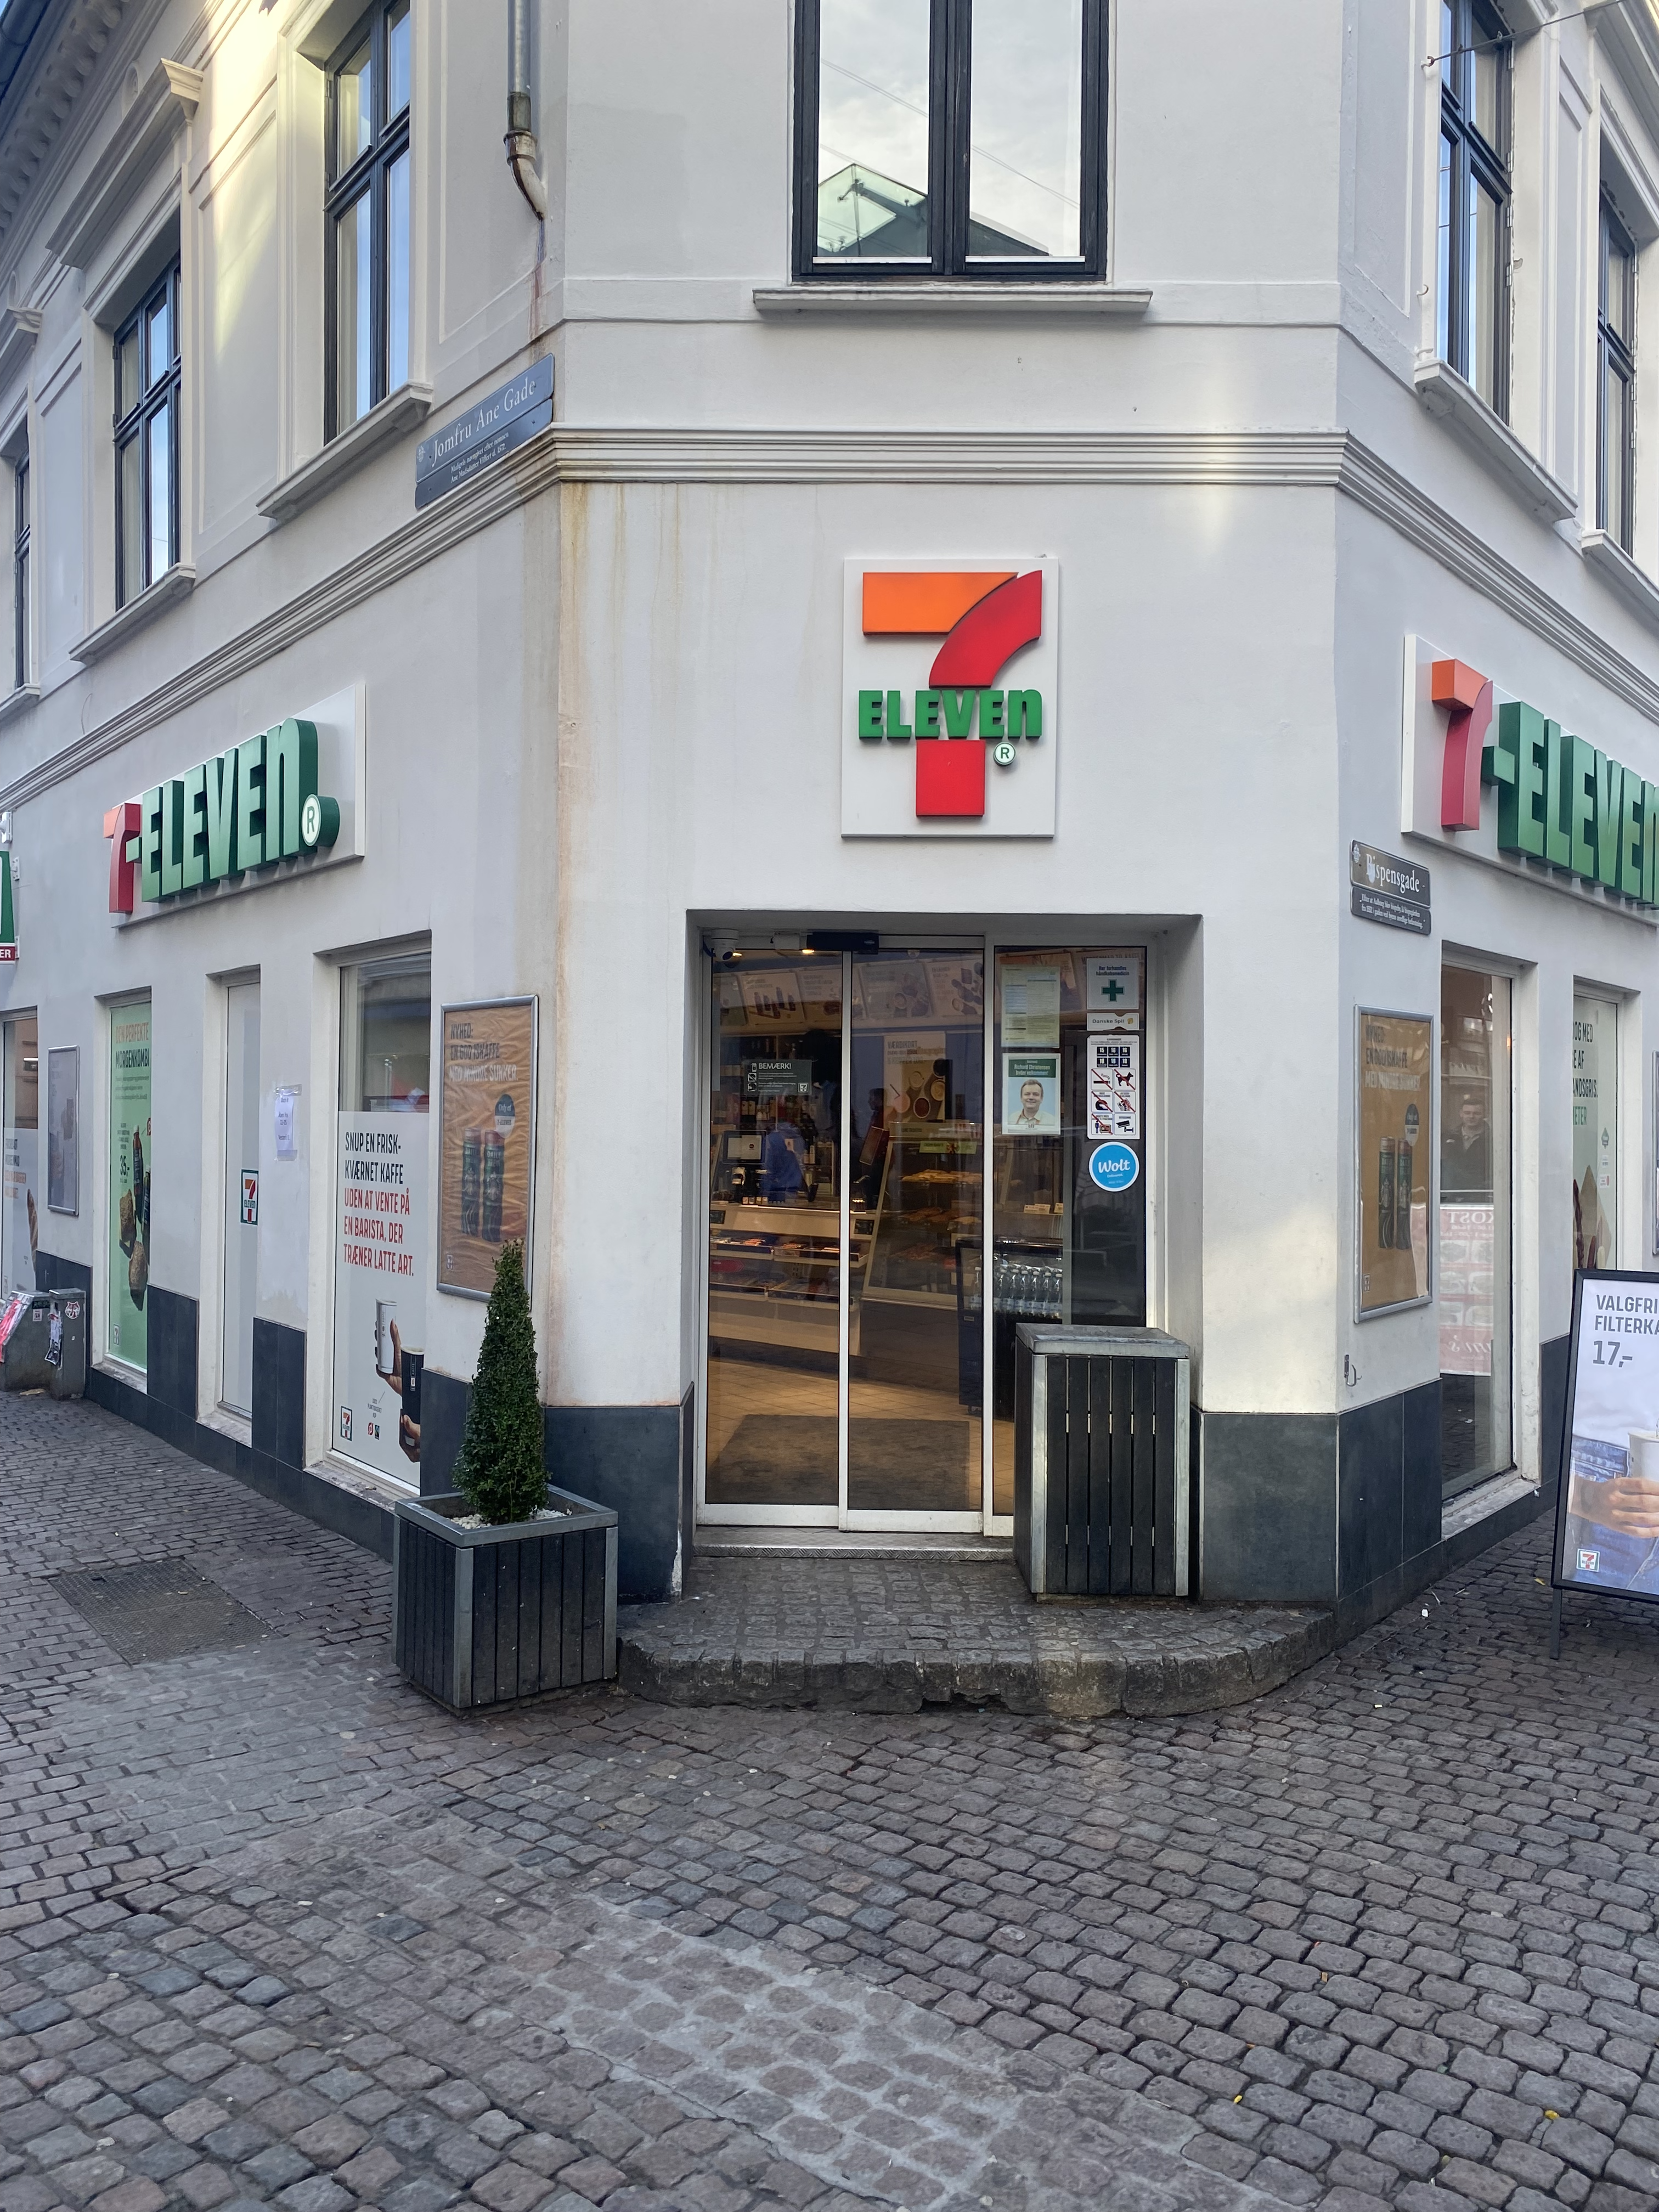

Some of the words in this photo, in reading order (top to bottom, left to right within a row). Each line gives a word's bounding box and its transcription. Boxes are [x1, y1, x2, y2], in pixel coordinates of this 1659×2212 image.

[432, 423, 472, 467] Jomfru
[476, 405, 500, 432] Ane
[504, 376, 537, 411] Gade
[1366, 854, 1420, 894] Bspensgade
[451, 1023, 473, 1039] NYHED:
[1573, 1022, 1581, 1041] OG
[1583, 1023, 1593, 1043] MED
[1578, 1050, 1584, 1069] AF
[489, 1064, 518, 1081] SUKKER.
[345, 1132, 364, 1152] SNUP
[366, 1133, 374, 1153] EN
[377, 1133, 401, 1154] FRISK-
[345, 1159, 379, 1181] KVÆRNET
[380, 1163, 403, 1184] KAFFE
[1098, 1159, 1130, 1173] Wolt
[345, 1187, 363, 1208] UDEN
[364, 1190, 373, 1210] AT
[375, 1191, 398, 1214] VENTE
[400, 1188, 410, 1216] PÅ
[344, 1215, 352, 1235] EN
[354, 1217, 386, 1243] BARISTA,
[388, 1222, 403, 1244] DER
[343, 1243, 372, 1268] TRÆNER
[374, 1249, 396, 1273] LATTE
[397, 1254, 414, 1277] ART.
[1596, 1294, 1658, 1314] VALGFRI
[1593, 1340, 1633, 1368] 17,-
